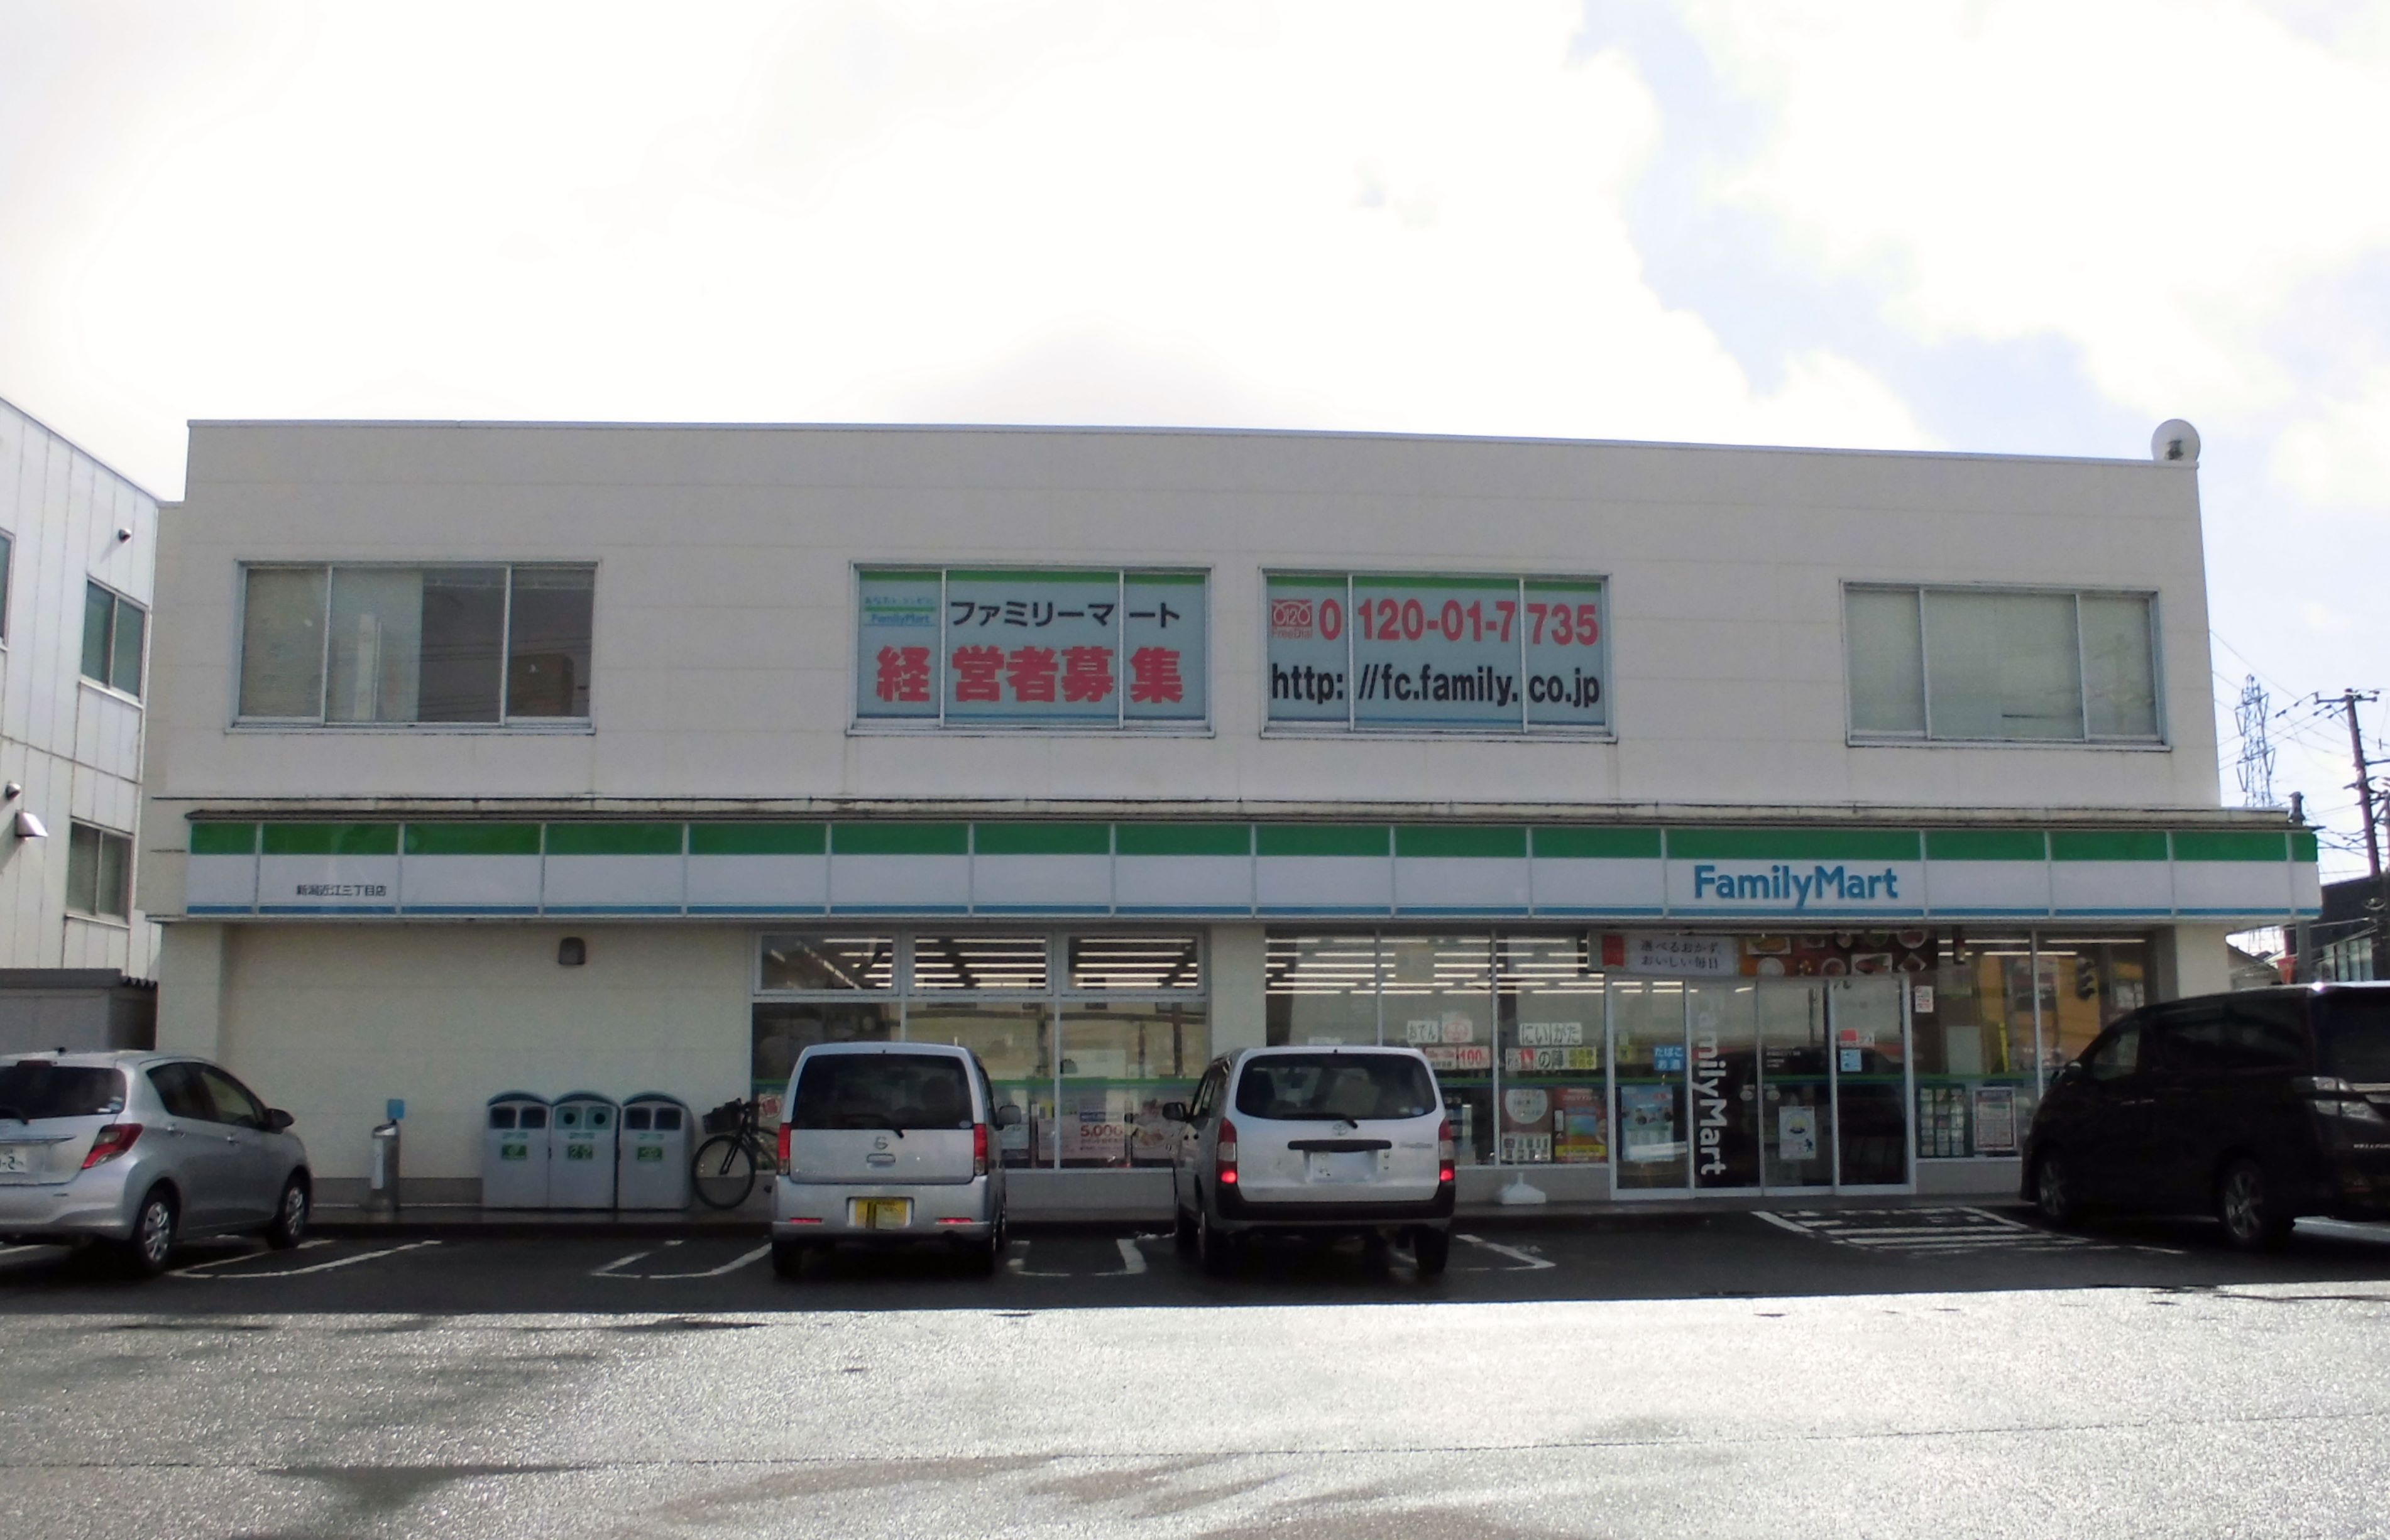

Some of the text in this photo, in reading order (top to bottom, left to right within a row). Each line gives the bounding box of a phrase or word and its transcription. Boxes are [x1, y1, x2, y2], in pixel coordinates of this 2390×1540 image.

[951, 601, 1180, 628] ファミリーマート
[876, 644, 1183, 704] 経営者募集
[1694, 865, 1898, 909] FamilyMart
[1692, 992, 1727, 1175] amilyMart
